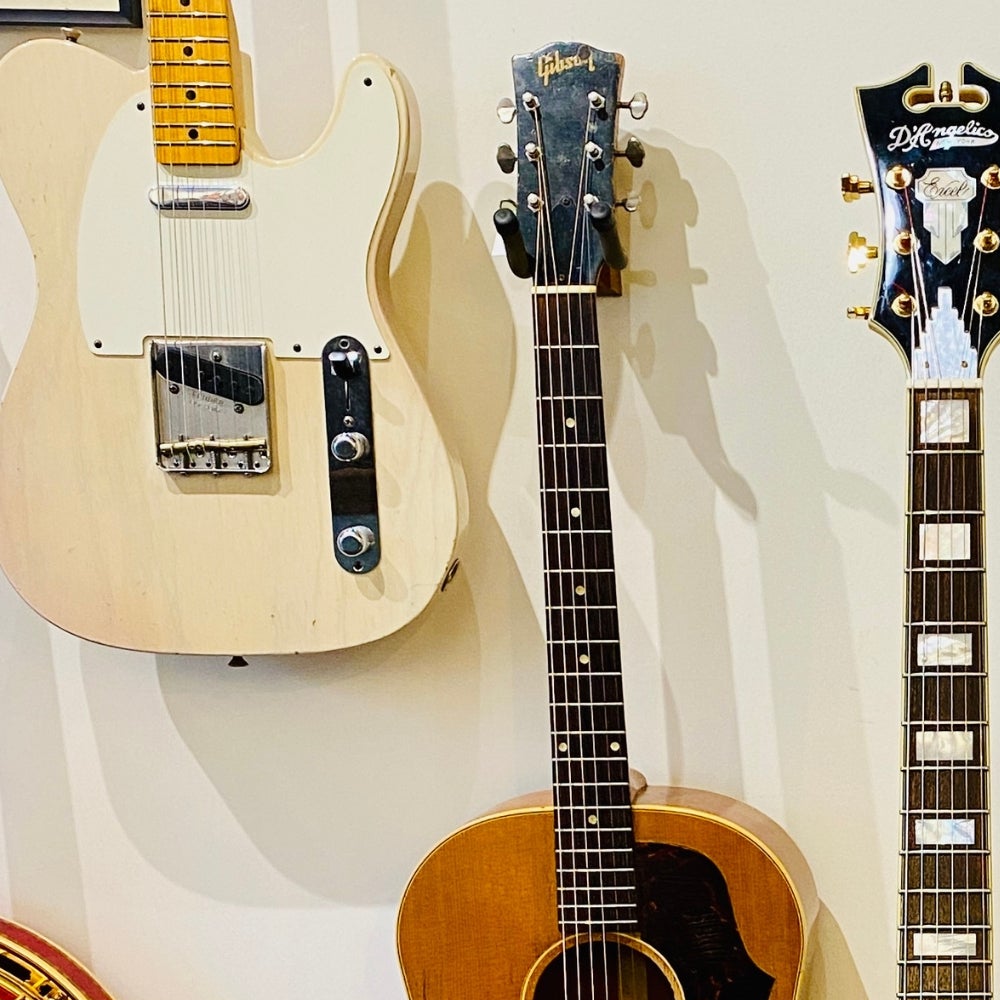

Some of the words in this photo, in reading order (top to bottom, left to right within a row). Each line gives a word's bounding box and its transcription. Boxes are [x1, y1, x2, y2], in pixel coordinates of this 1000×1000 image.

[538, 50, 595, 87] Gibson
[887, 120, 999, 152] D'Angelico
[923, 177, 970, 200] Excel
